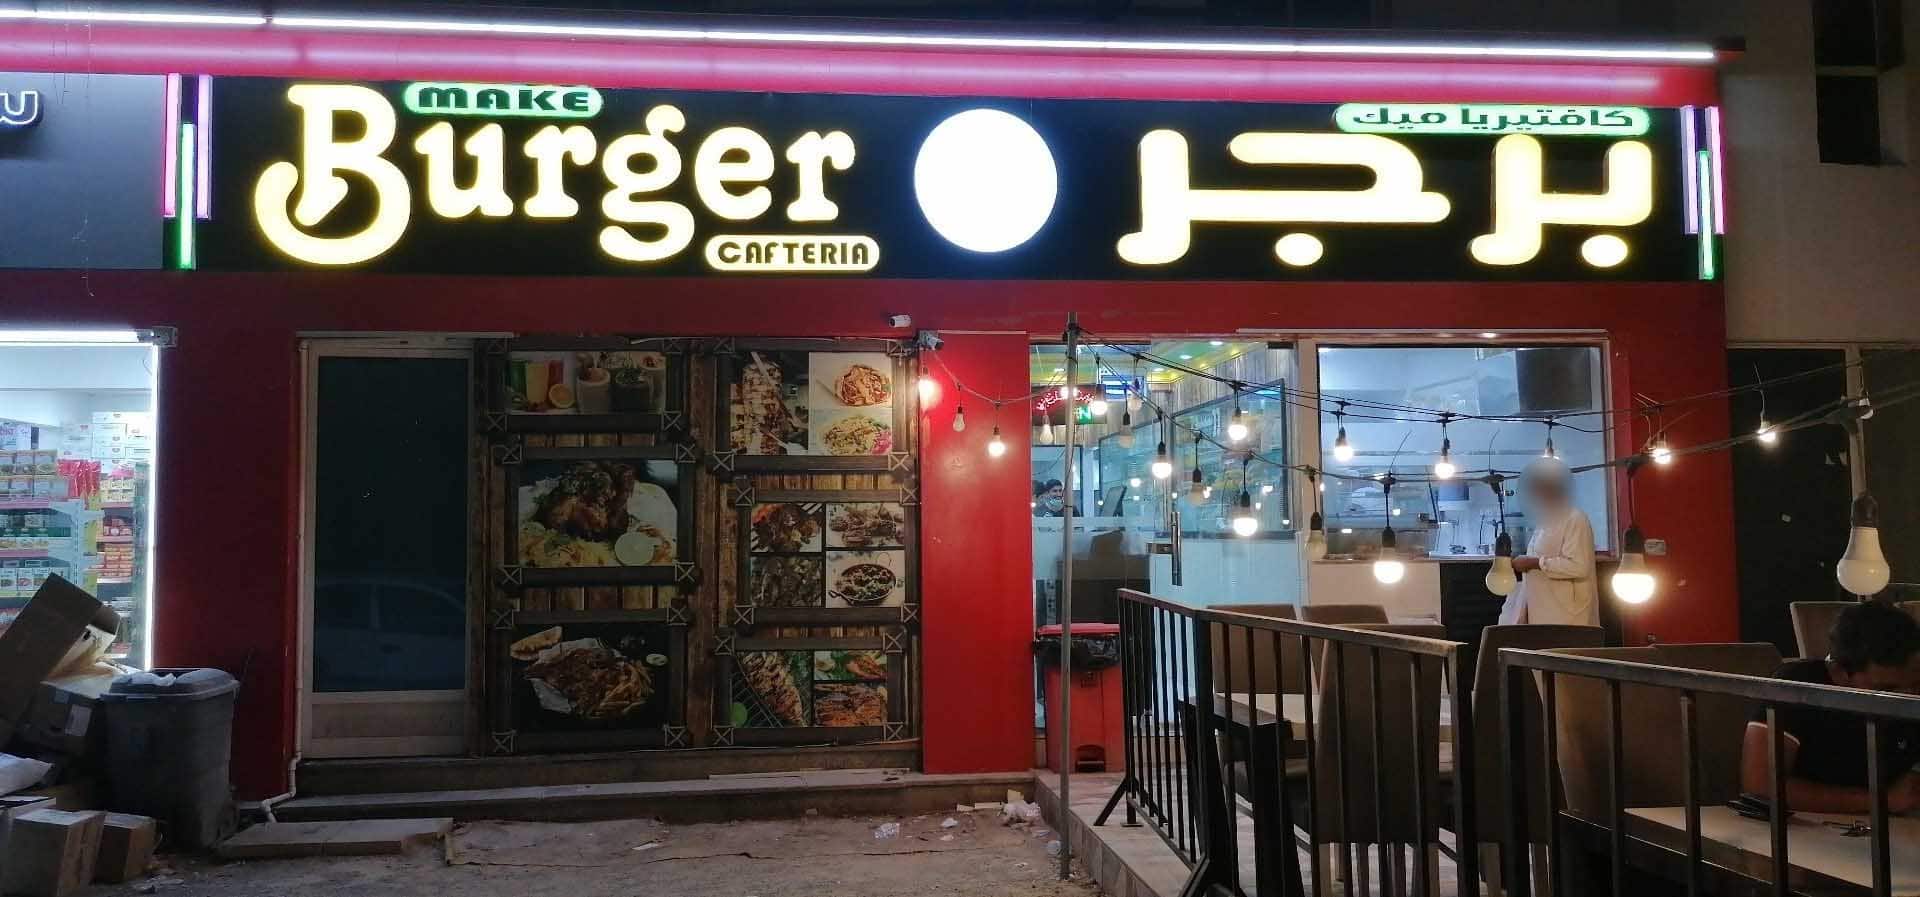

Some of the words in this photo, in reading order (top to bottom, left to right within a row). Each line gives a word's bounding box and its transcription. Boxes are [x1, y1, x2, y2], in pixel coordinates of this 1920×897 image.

[418, 87, 589, 112] MAKE
[1353, 107, 1447, 129] ميك
[1461, 107, 1633, 130] كافتيريا
[254, 84, 856, 265] Burger
[1117, 129, 1653, 268] برجر
[717, 241, 869, 264] CAFTERIA
